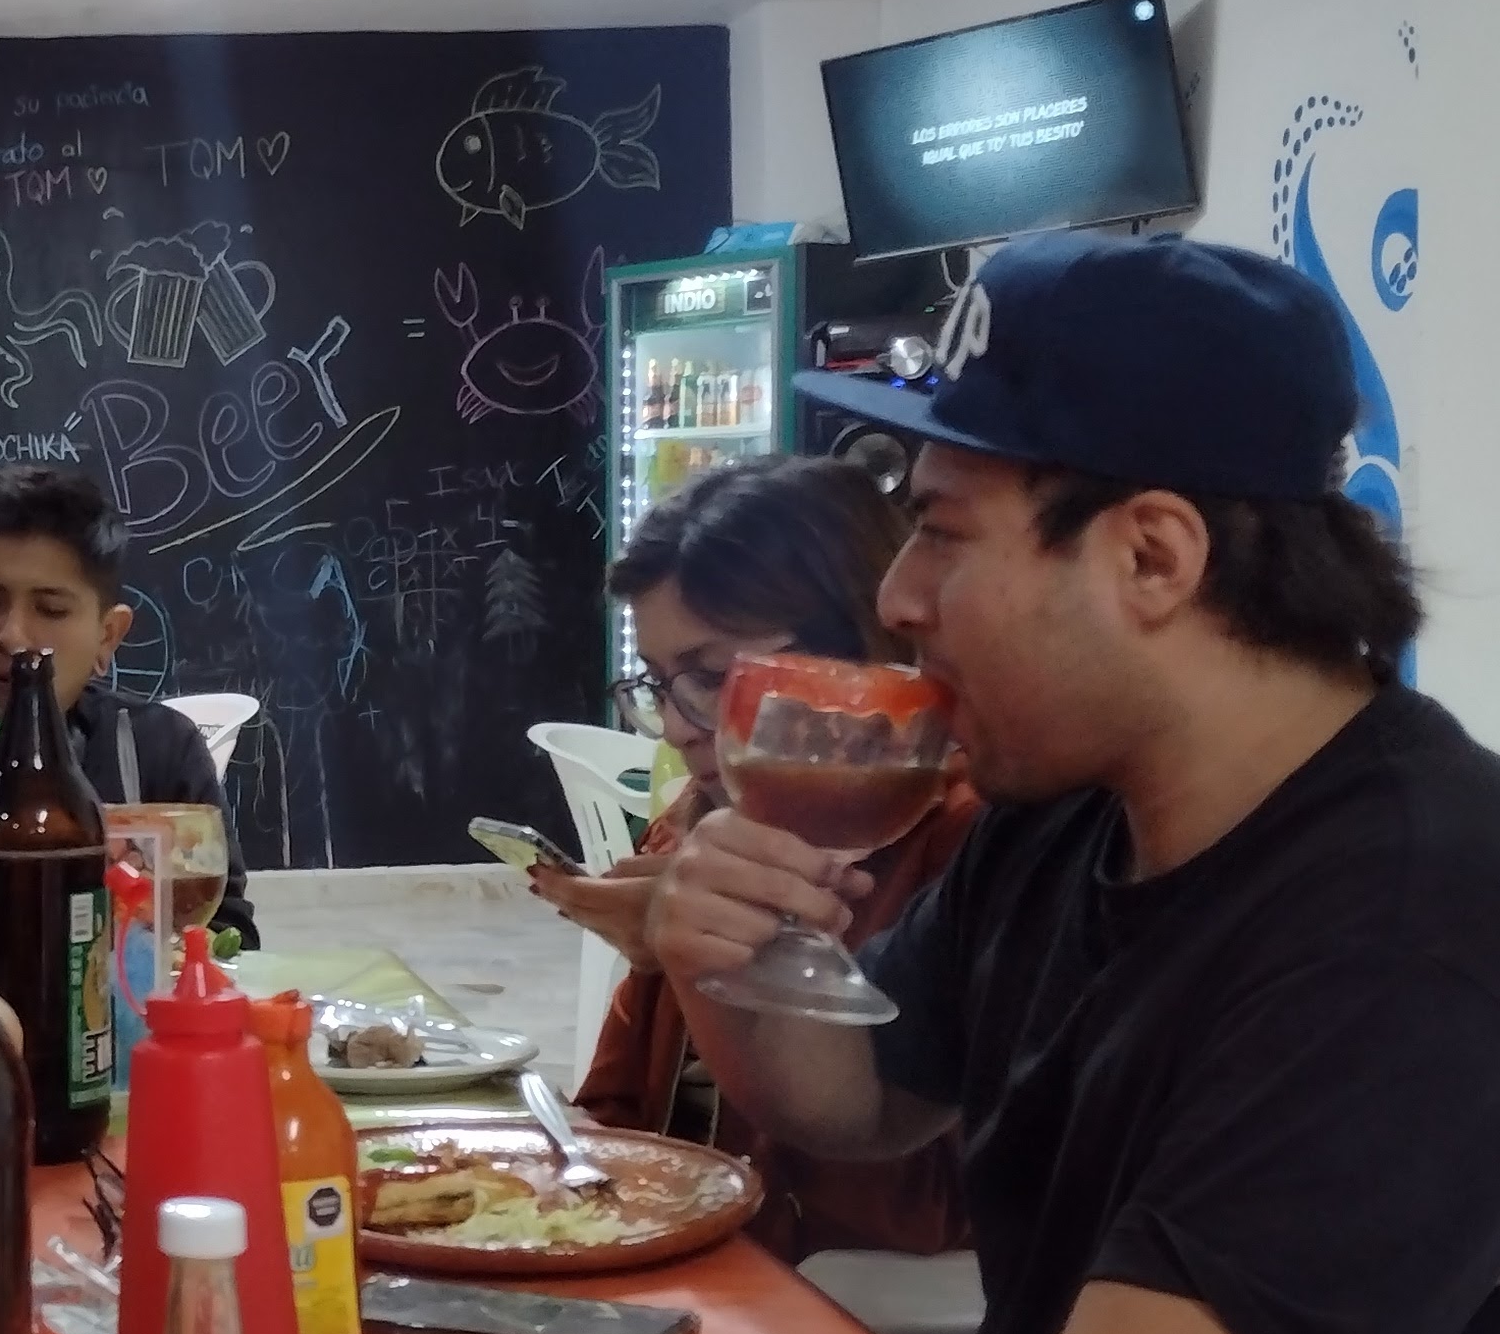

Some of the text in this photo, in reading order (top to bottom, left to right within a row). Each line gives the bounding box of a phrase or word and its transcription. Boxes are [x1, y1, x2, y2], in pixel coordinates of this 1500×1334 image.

[13, 96, 41, 116] su
[912, 96, 1088, 145] LOS ERRORES SON PLACERES
[61, 129, 83, 158] al
[145, 135, 246, 186] TQM
[922, 146, 959, 166] IGUAL
[959, 140, 986, 160] QUE
[1009, 131, 1035, 148] TUS
[4, 165, 72, 207] TQM
[664, 288, 717, 315] INDIO
[80, 316, 351, 538] Beer
